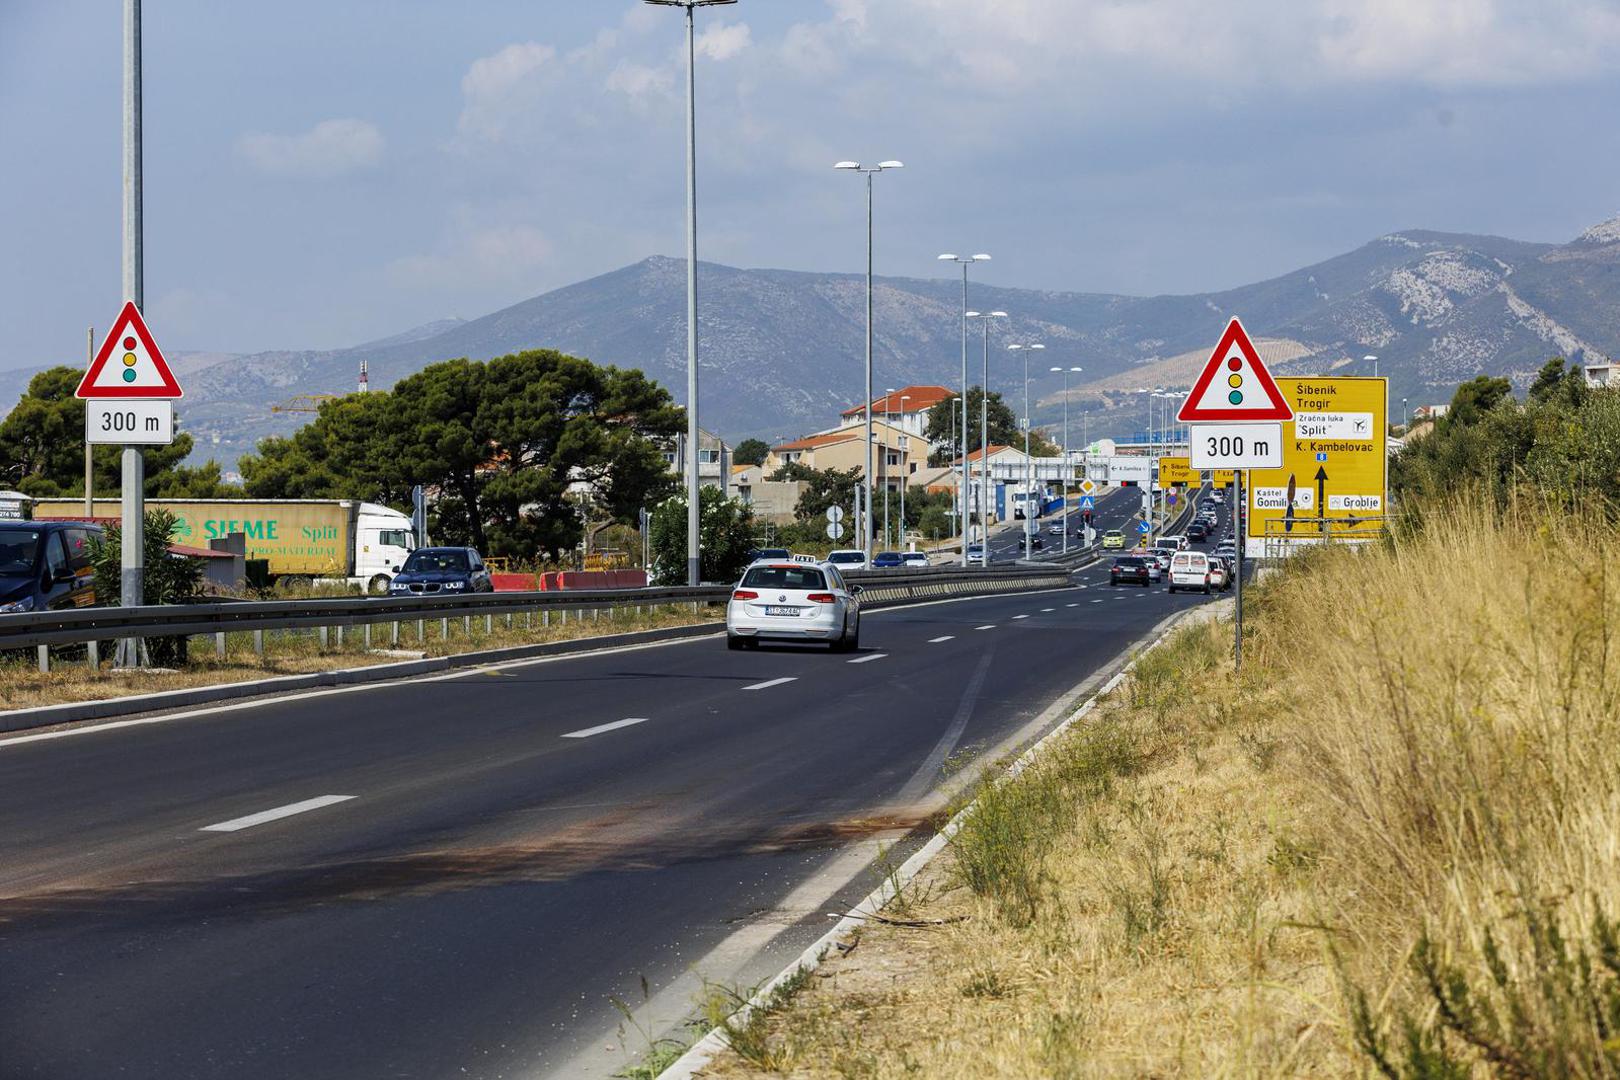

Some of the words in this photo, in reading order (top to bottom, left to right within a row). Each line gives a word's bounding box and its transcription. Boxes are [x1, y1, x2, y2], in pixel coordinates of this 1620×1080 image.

[1296, 382, 1337, 395] Šibenik
[1296, 398, 1331, 410] Trogir
[102, 412, 136, 431] 300
[145, 416, 159, 431] m
[1327, 414, 1344, 422] luka
[1207, 436, 1243, 457] 300
[1254, 441, 1268, 456] m
[1296, 442, 1307, 452] K.
[1310, 441, 1374, 452] Kambelovac
[1257, 497, 1299, 508] Gomilia
[1343, 497, 1379, 509] Groblje
[301, 525, 338, 543] Split
